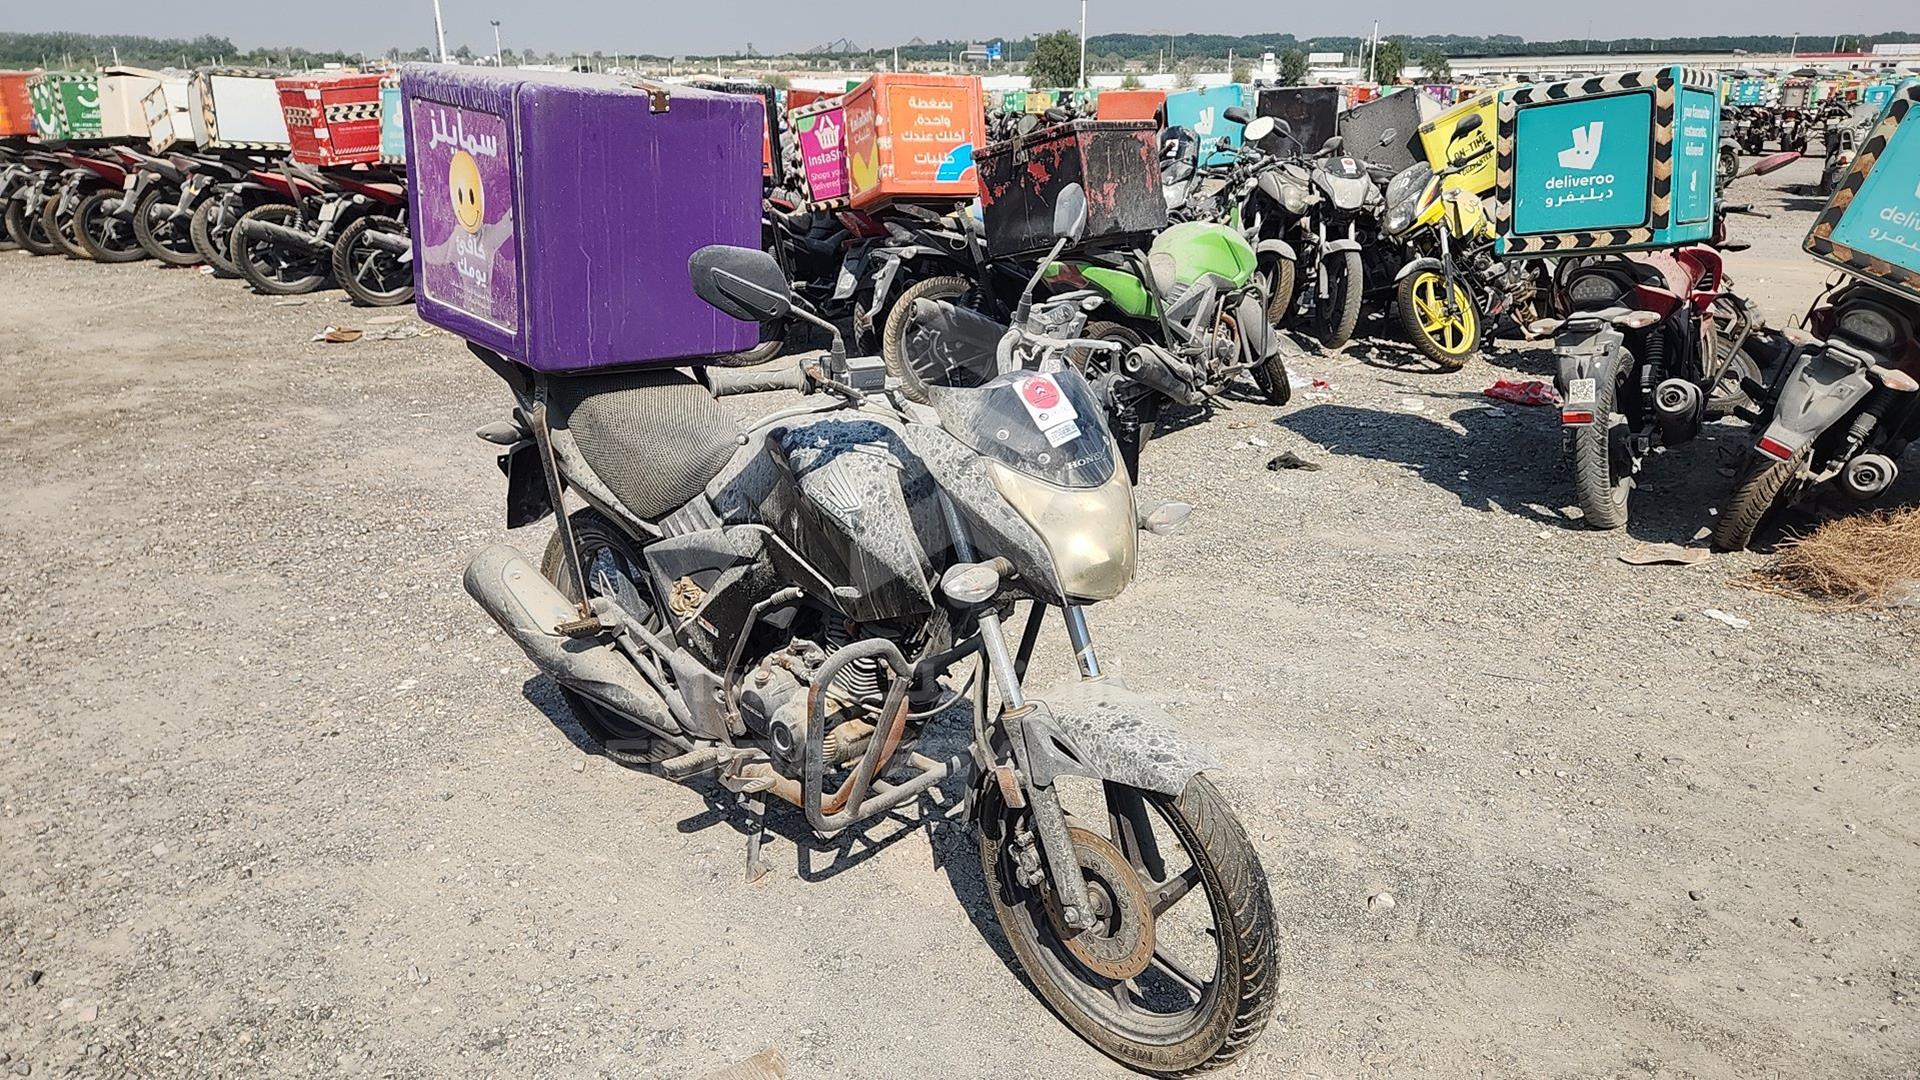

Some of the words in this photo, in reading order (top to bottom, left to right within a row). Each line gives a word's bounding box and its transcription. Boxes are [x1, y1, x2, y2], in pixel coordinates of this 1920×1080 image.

[908, 96, 953, 112] بضغطة
[429, 108, 498, 158] سمايلز
[901, 130, 935, 144] عندك
[935, 127, 965, 143] أكلك
[1454, 132, 1489, 159] ON-TIME
[808, 149, 848, 168] InstaSho
[914, 152, 956, 168] طلبات
[1545, 174, 1615, 190] deliveroo
[1545, 188, 1613, 208] ديليفرو
[1880, 205, 1920, 232] deliv
[1067, 451, 1109, 470] HONDA
